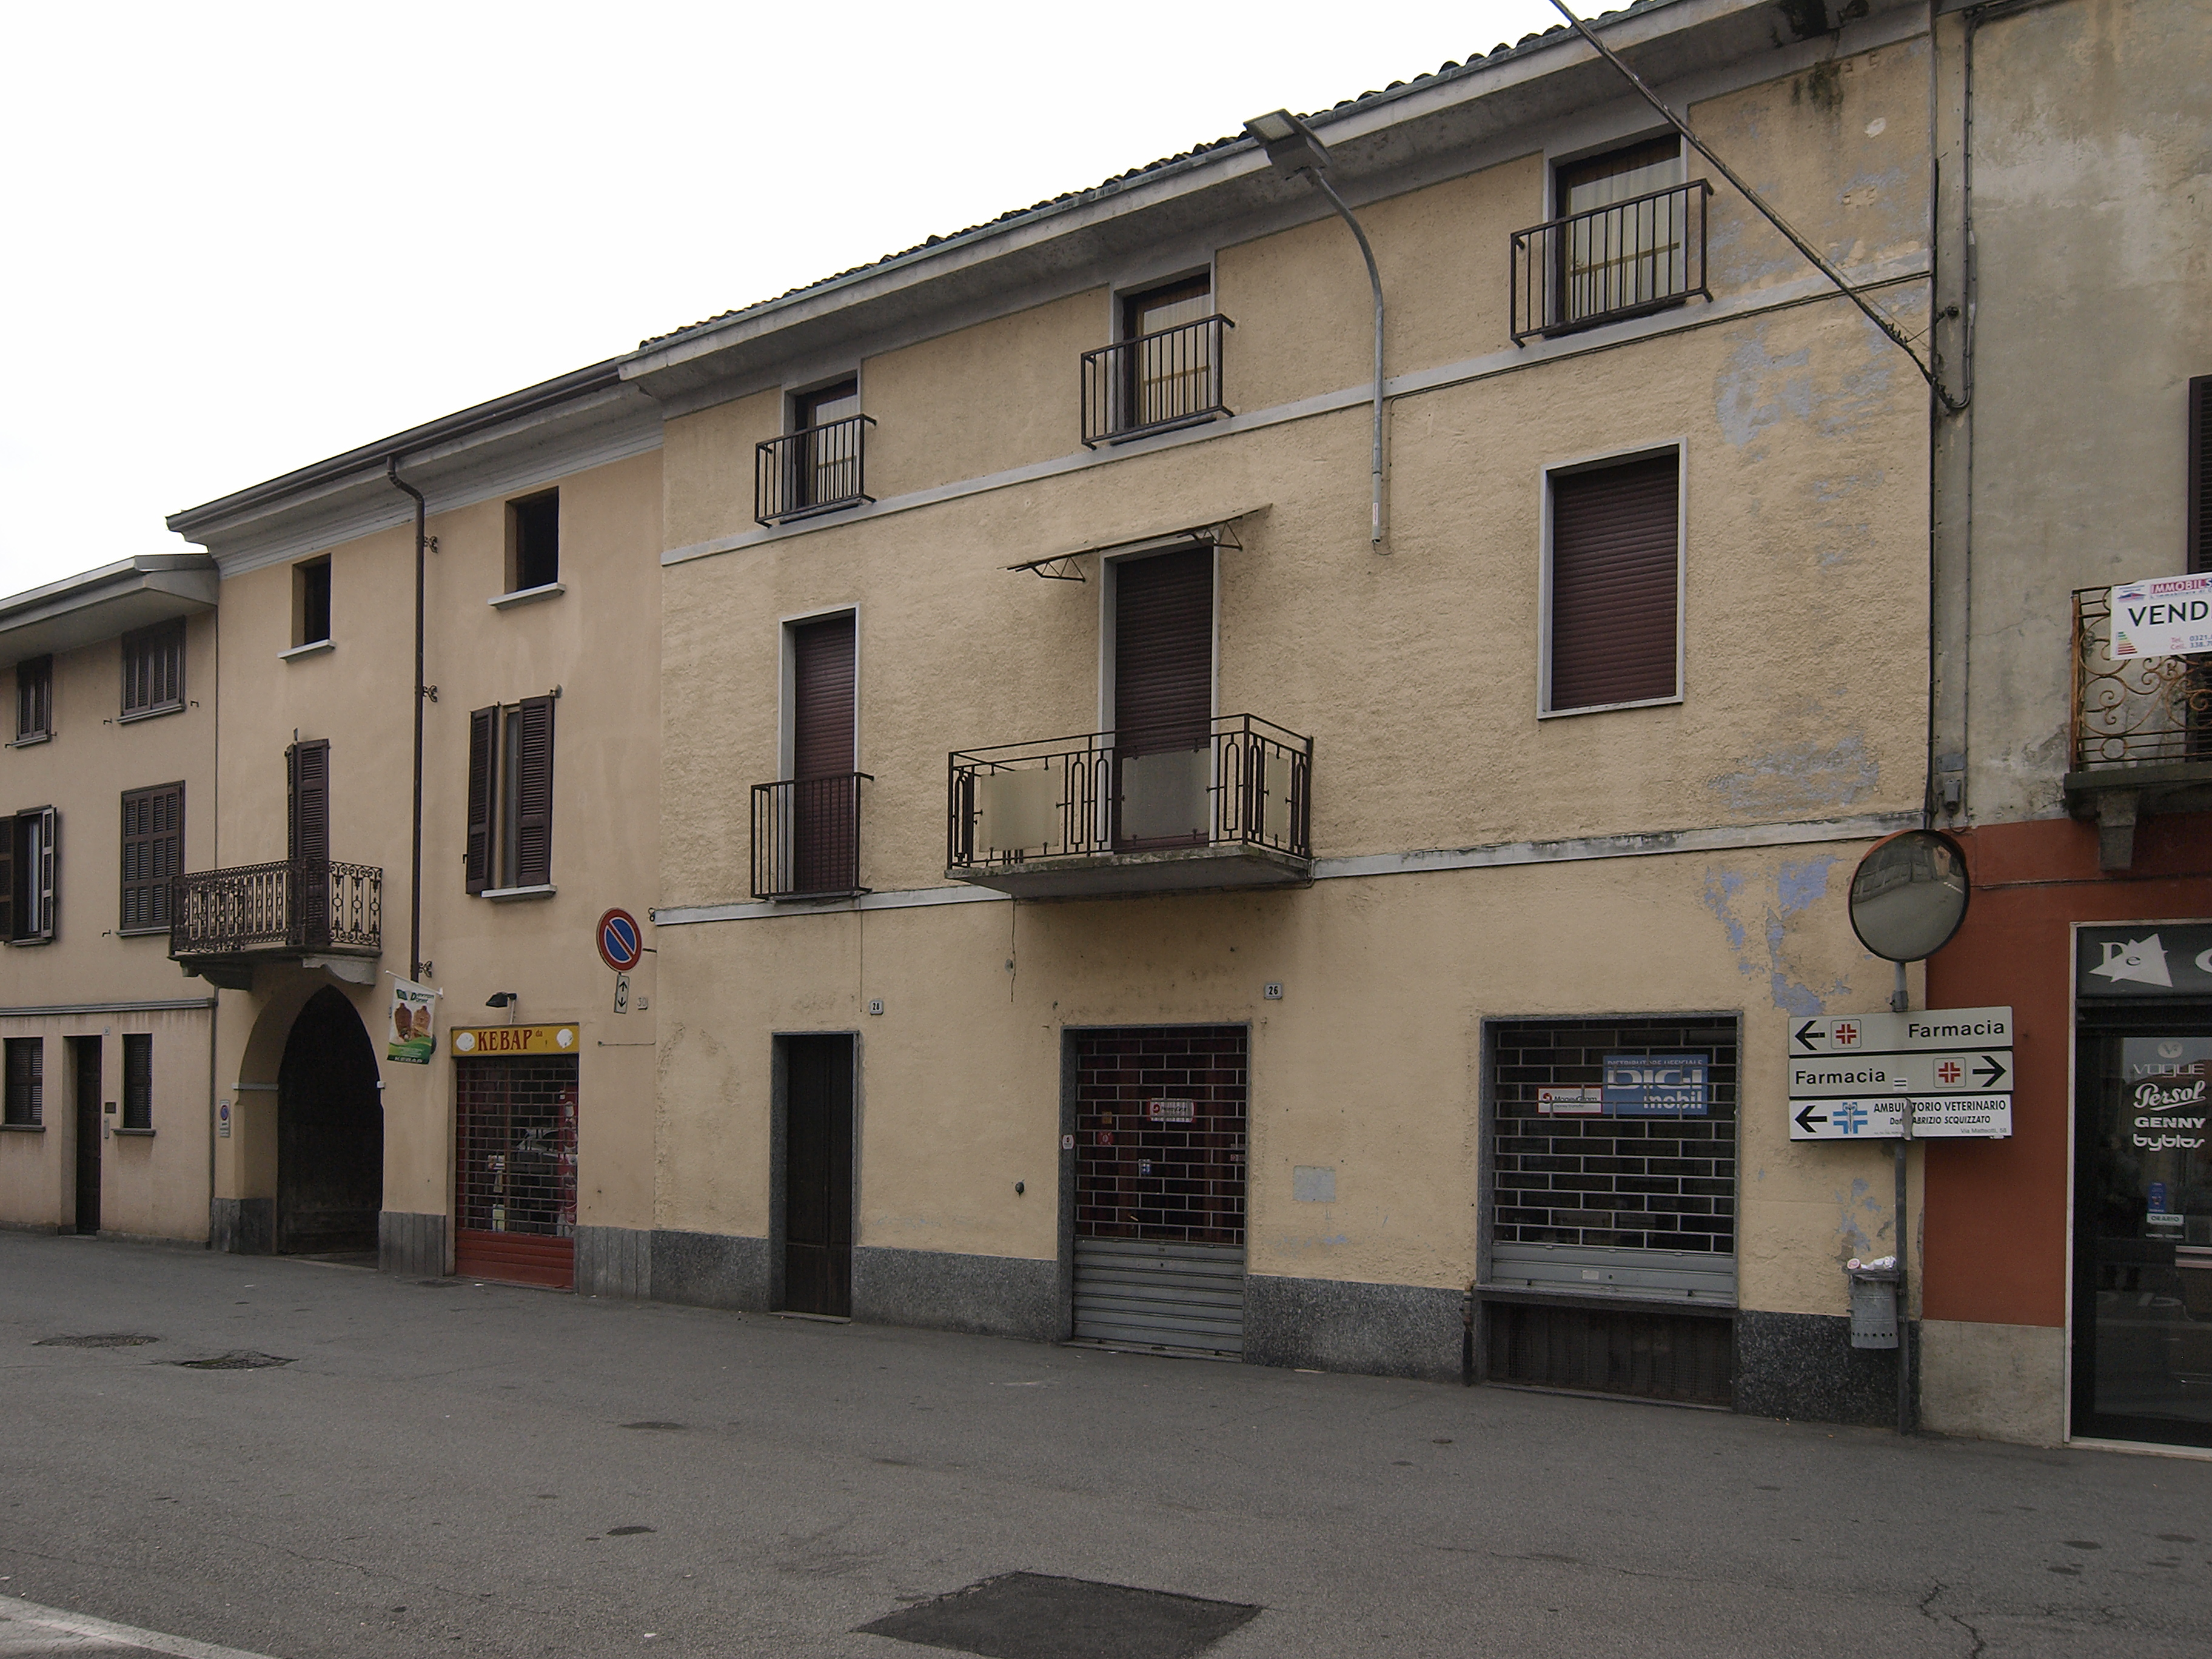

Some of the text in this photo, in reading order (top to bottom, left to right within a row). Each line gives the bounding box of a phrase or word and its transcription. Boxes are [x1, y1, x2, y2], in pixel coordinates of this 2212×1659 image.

[2128, 600, 2212, 626] VEND
[1269, 986, 1278, 995] 26
[1908, 1020, 2005, 1039] Farmacia
[478, 1030, 533, 1051] KEBAP
[1607, 1069, 1702, 1089] DIGI
[1795, 1068, 1886, 1085] Farmacia
[1644, 1091, 1702, 1109] mobil
[2133, 1080, 2207, 1110] Persol
[1874, 1100, 2006, 1113] AMBULTORIO VETERINARIO
[1911, 1116, 1941, 1125] ABRIZIO
[1944, 1115, 1991, 1125] SCQUIZZATO
[2134, 1116, 2206, 1129] GENNY
[2133, 1133, 2205, 1151] byblos
